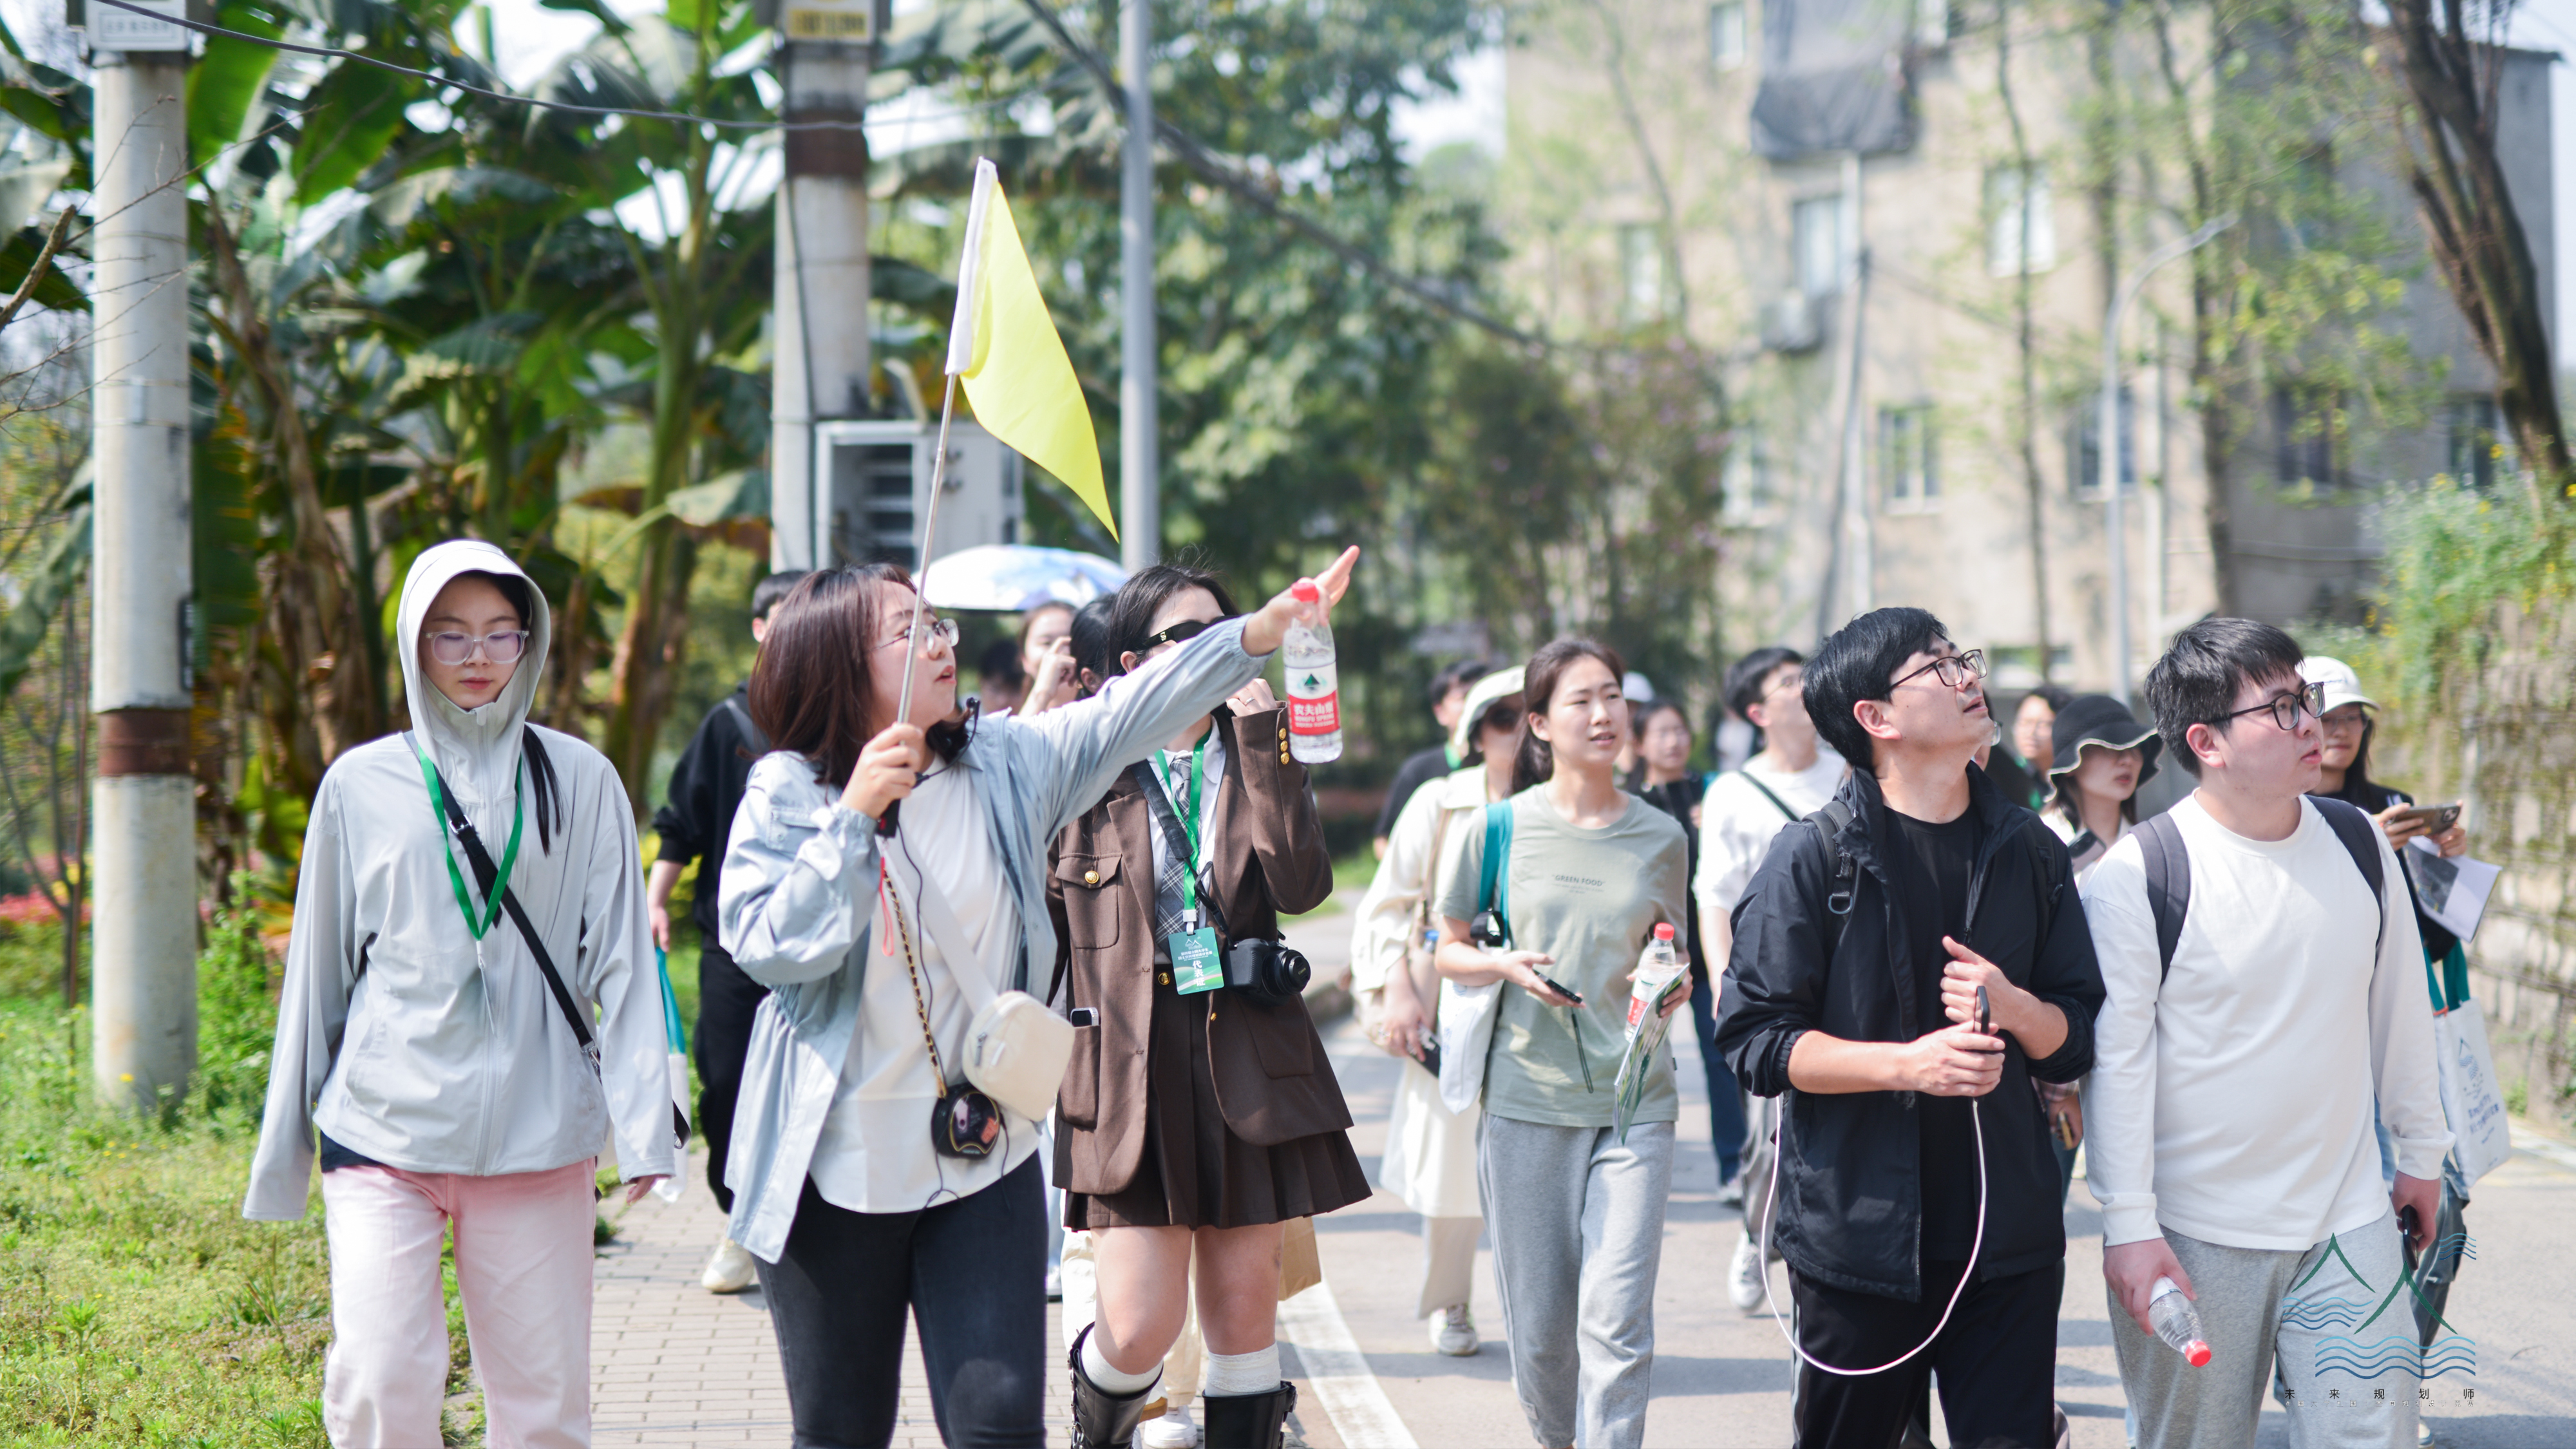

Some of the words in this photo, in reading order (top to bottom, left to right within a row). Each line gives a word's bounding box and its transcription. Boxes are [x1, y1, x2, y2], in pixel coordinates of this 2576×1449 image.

[1294, 701, 1333, 715] 农夫山泉
[1193, 960, 1206, 986] 代表证
